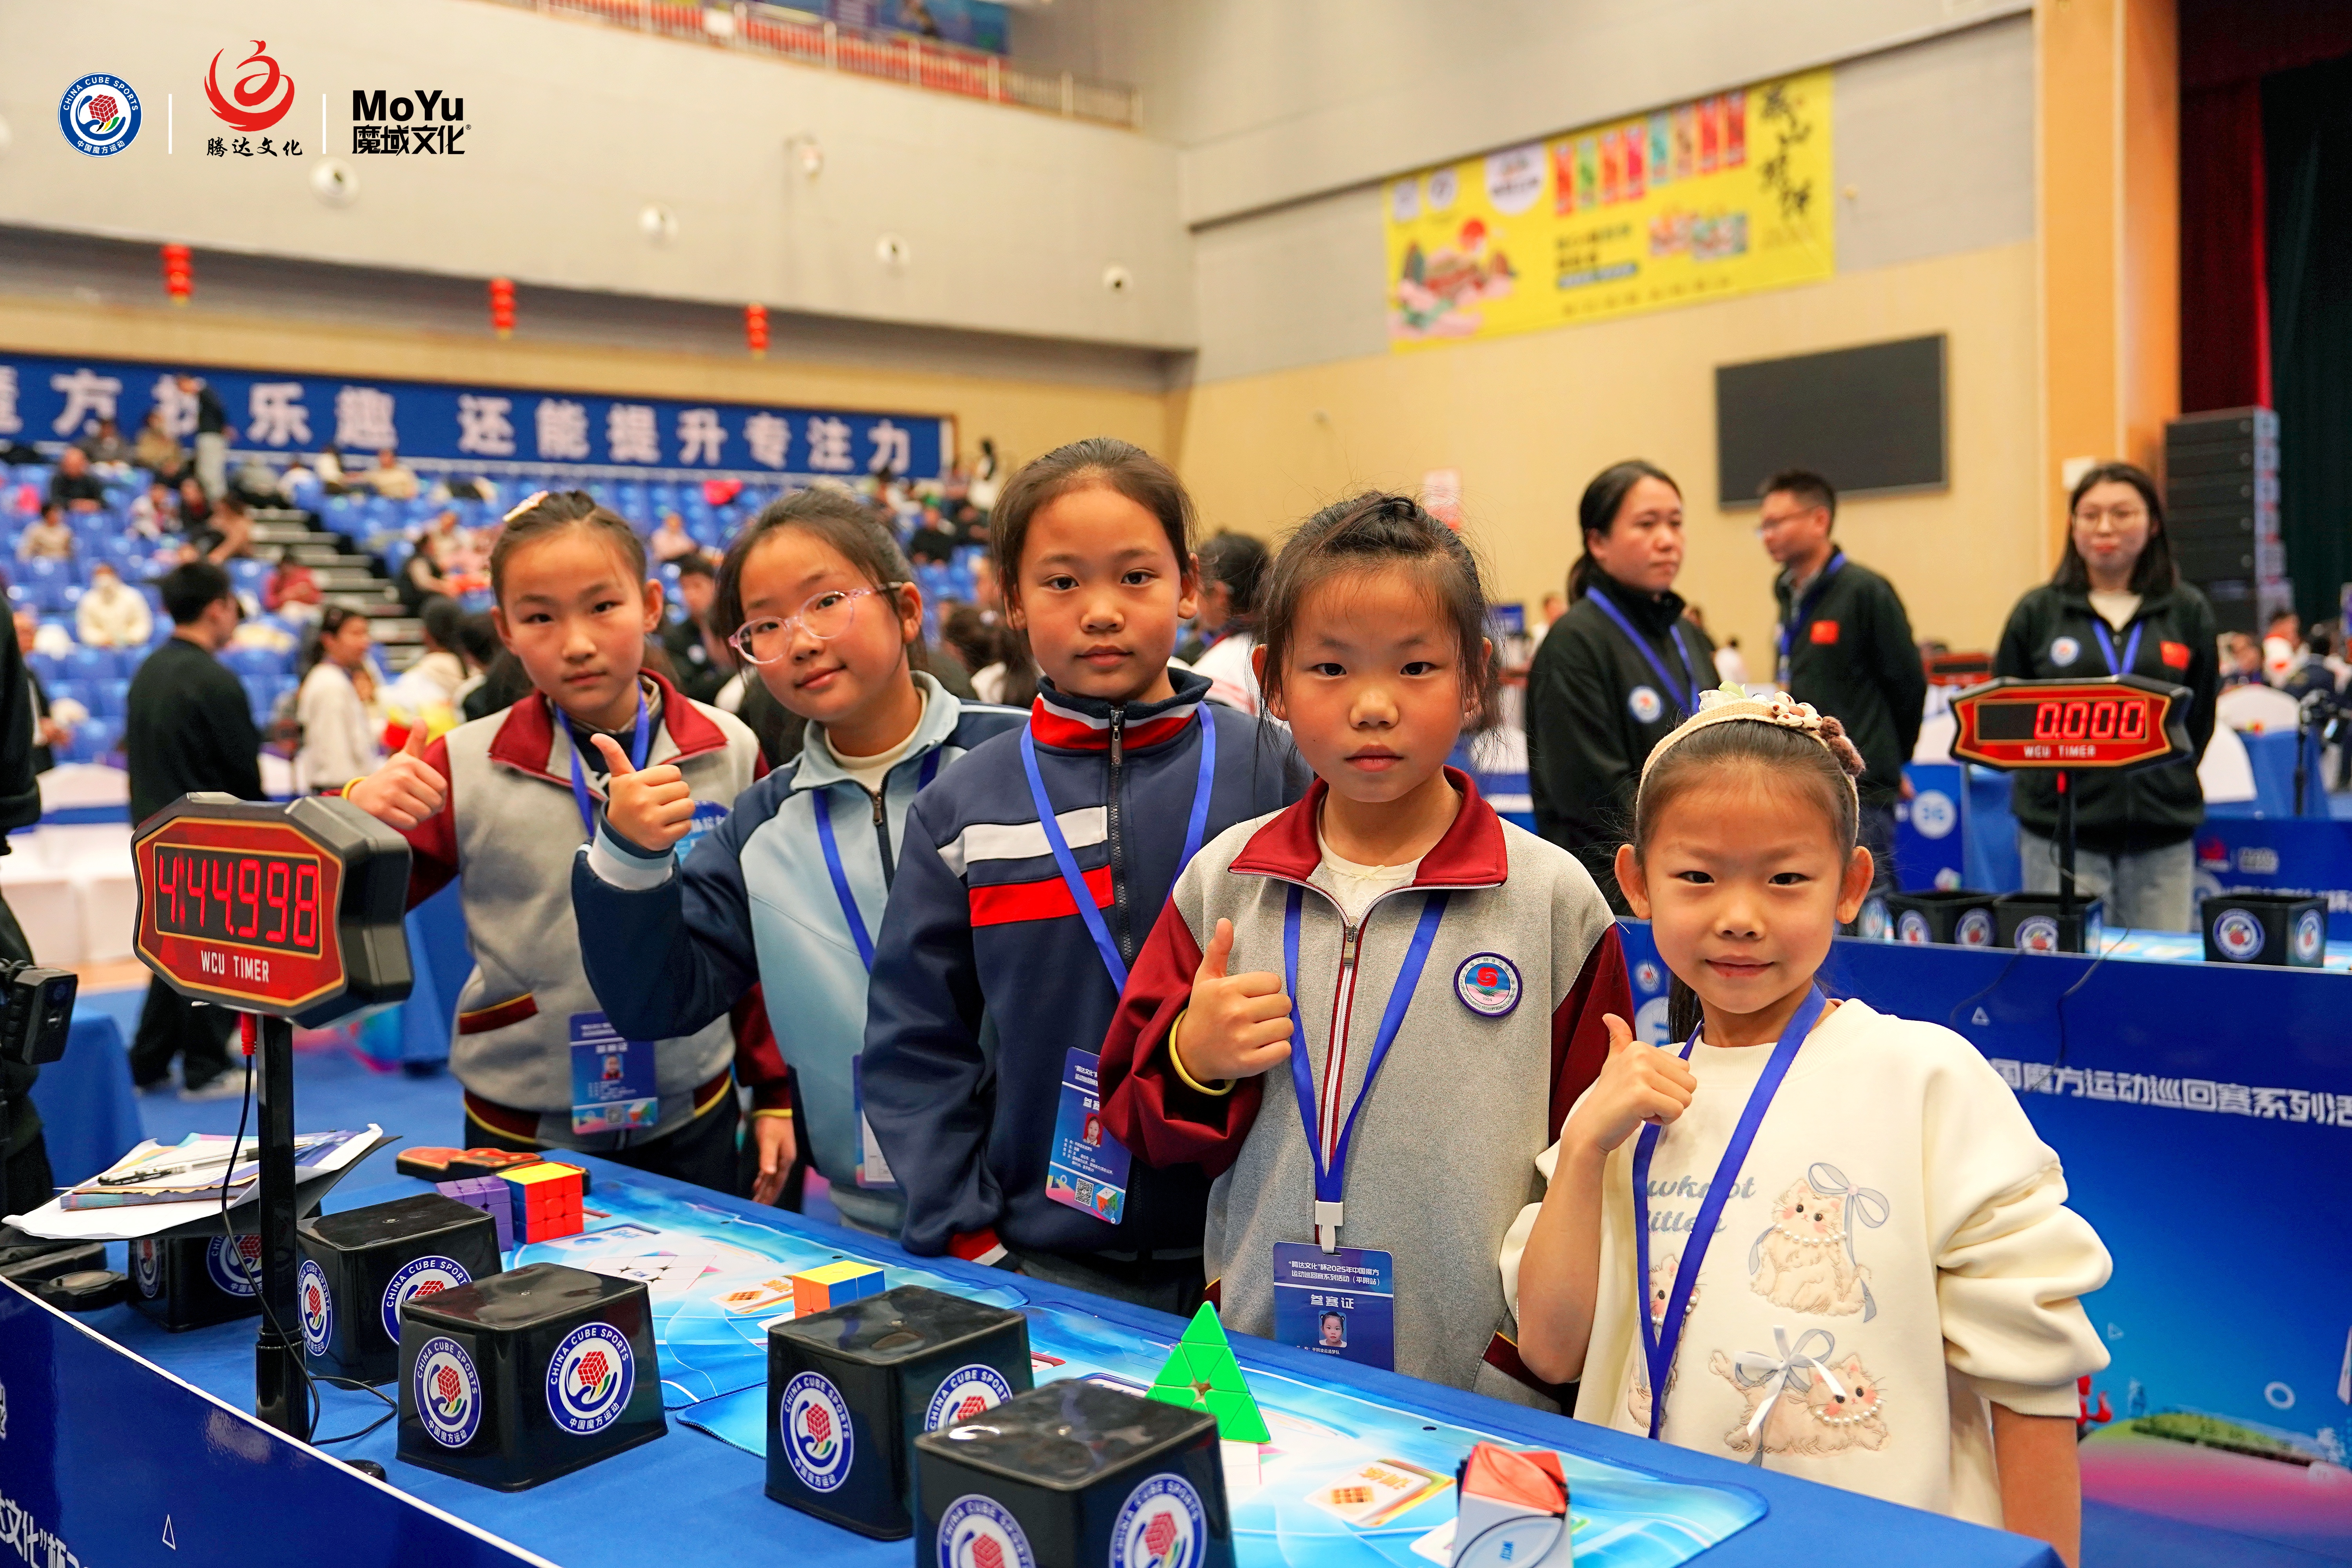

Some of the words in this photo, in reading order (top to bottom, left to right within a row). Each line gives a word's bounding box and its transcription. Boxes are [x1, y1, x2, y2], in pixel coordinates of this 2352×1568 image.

[457, 395, 912, 474] 还能提升专注力
[2034, 699, 2147, 740] 0.000
[2023, 745, 2051, 758] WCU
[2058, 744, 2096, 758] TIMER
[201, 949, 225, 975] WCU
[233, 954, 270, 983] TIMER
[1082, 1096, 1100, 1111] 参赛
[306, 1265, 318, 1275] CUBE
[318, 1272, 331, 1311] SPORTS
[386, 1275, 407, 1308] CHINA
[408, 1259, 436, 1274] CUBE
[439, 1261, 467, 1284] SPORT
[1310, 1294, 1355, 1310] 参赛证
[417, 1348, 433, 1379] CHINA
[434, 1341, 454, 1354] CUBE
[456, 1350, 478, 1395] SPORTS
[550, 1347, 570, 1385] CHINA
[571, 1327, 597, 1345] CUBE
[600, 1328, 629, 1361] SPORTS
[569, 1401, 620, 1430] 中国魔方运动
[784, 1381, 803, 1414] CHINA
[803, 1377, 827, 1392] CUBE
[827, 1388, 850, 1439] SPORTS
[928, 1389, 950, 1431] CHINA
[949, 1370, 978, 1388] CUBE
[980, 1371, 1009, 1401] SPORT
[428, 1419, 467, 1443] 中国魔方运动
